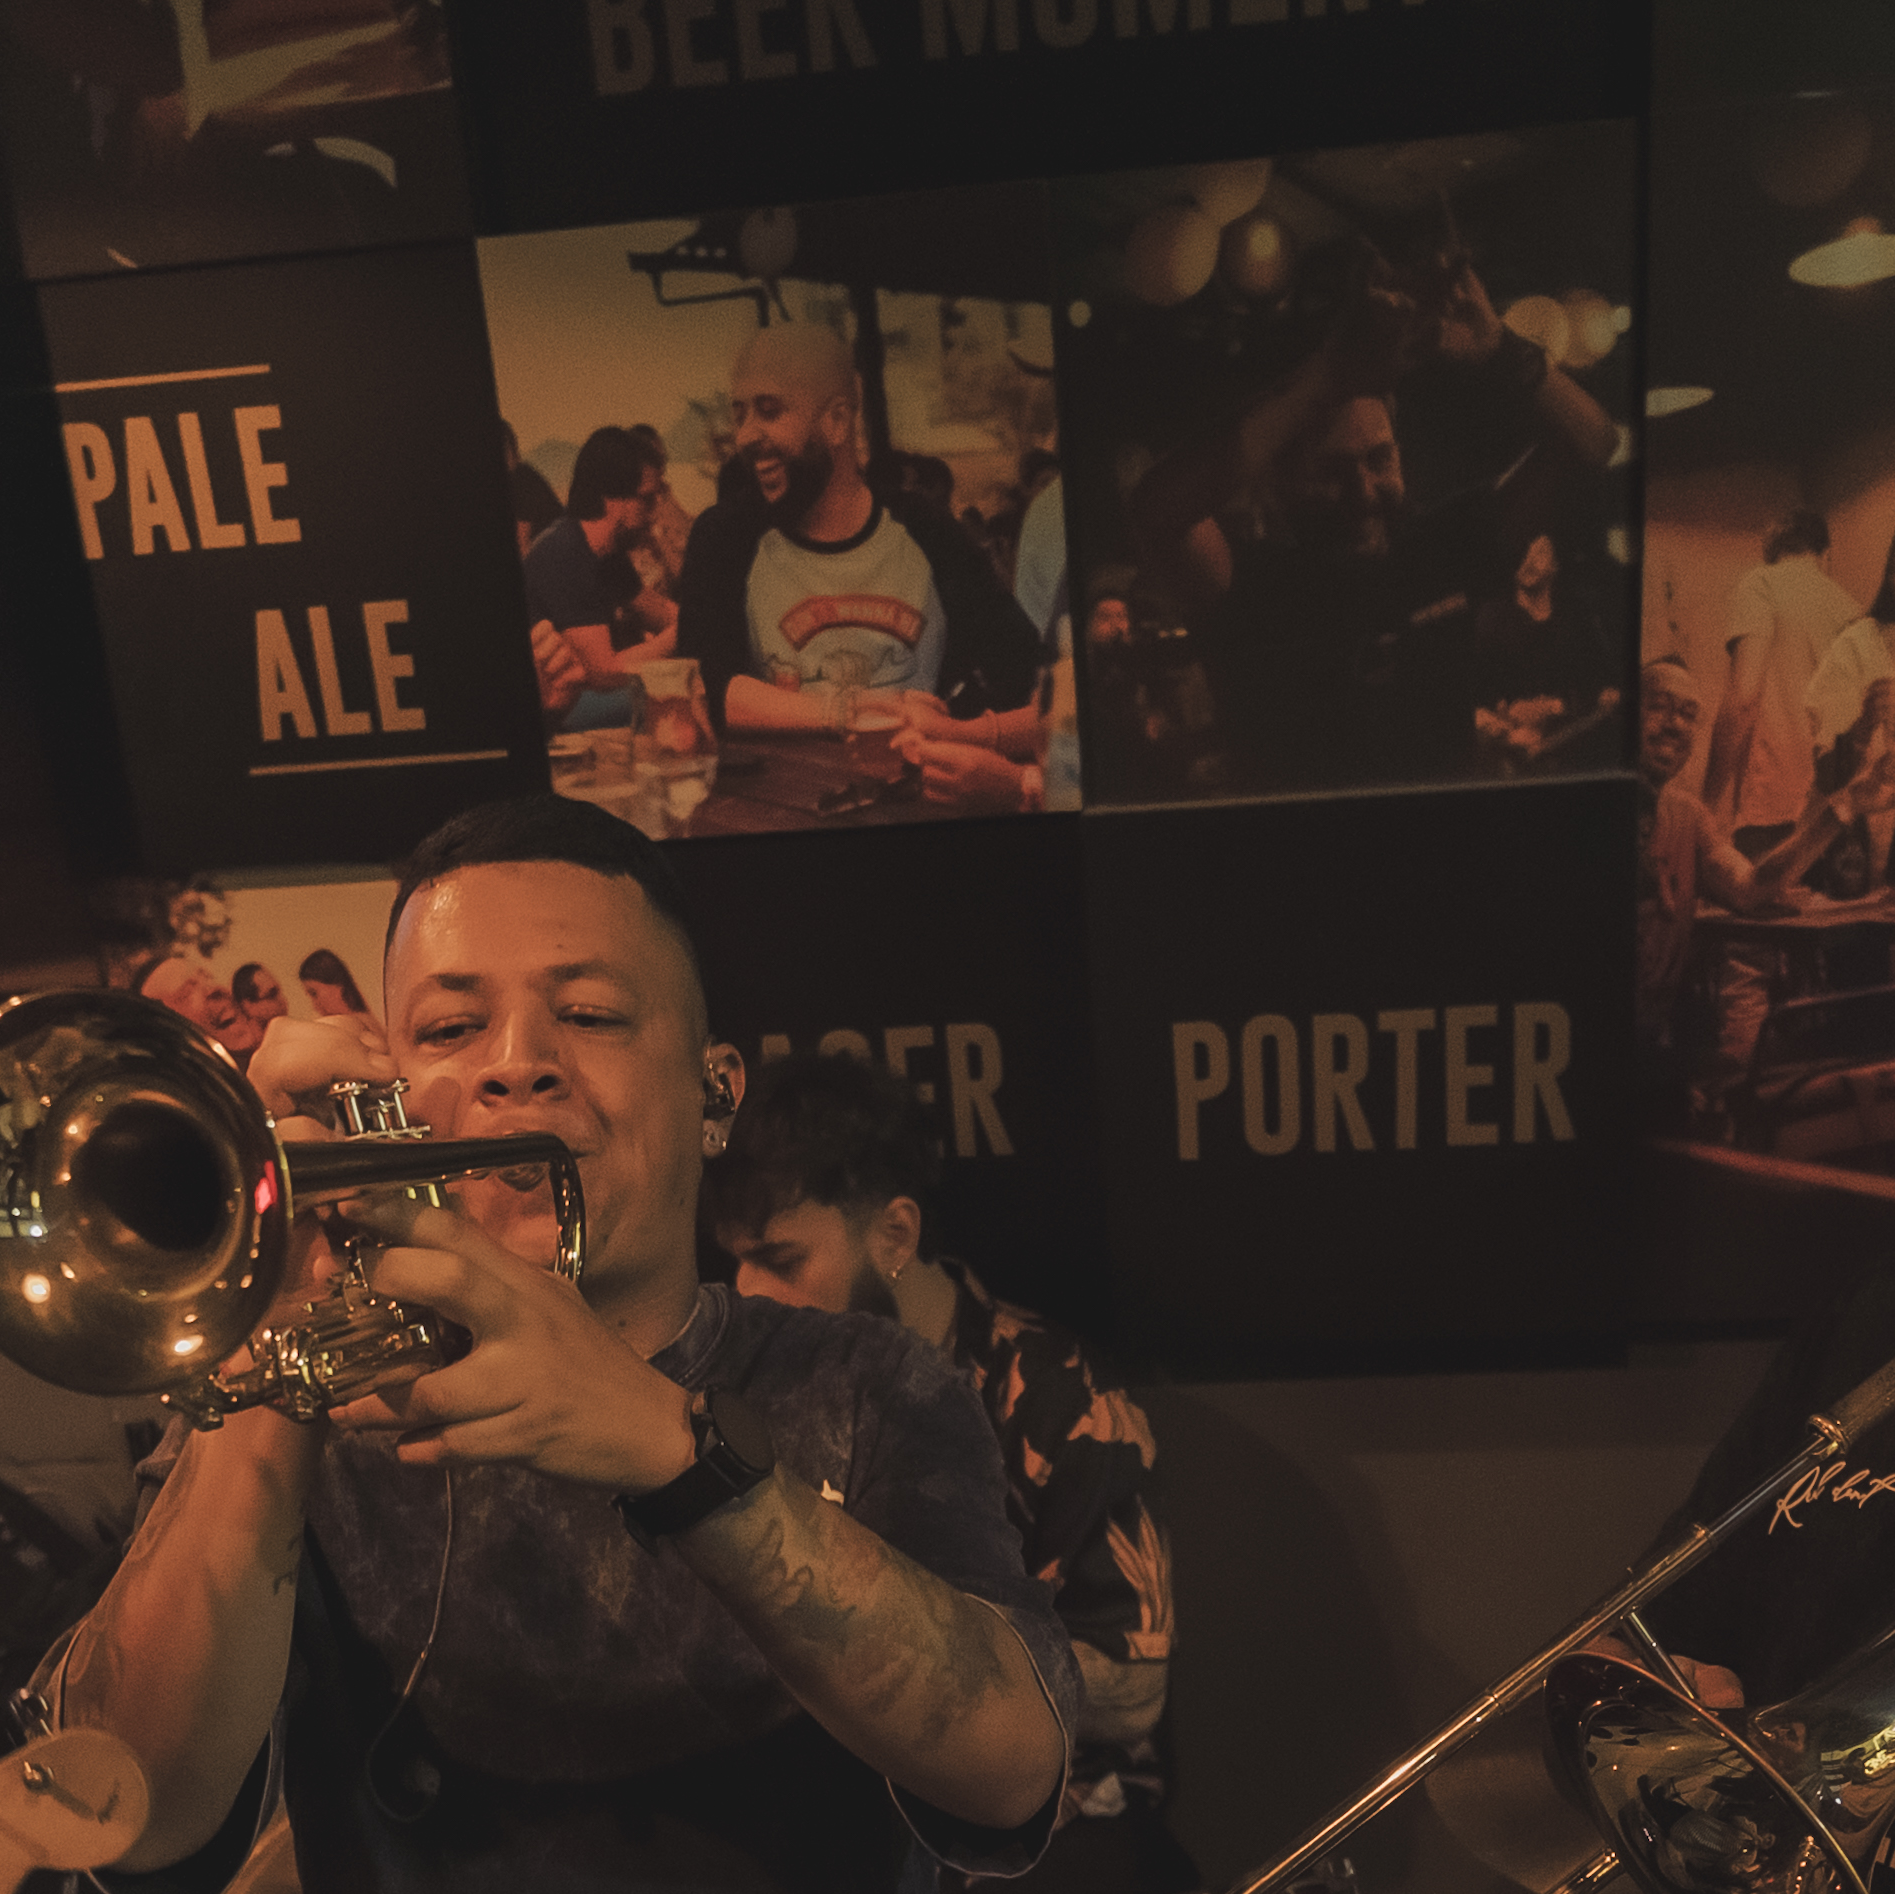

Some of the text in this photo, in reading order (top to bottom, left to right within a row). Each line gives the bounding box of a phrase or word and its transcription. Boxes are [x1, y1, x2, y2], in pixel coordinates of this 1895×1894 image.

[61, 404, 303, 560] PALE
[254, 599, 428, 742] ALE
[1171, 1000, 1578, 1161] PORTER
